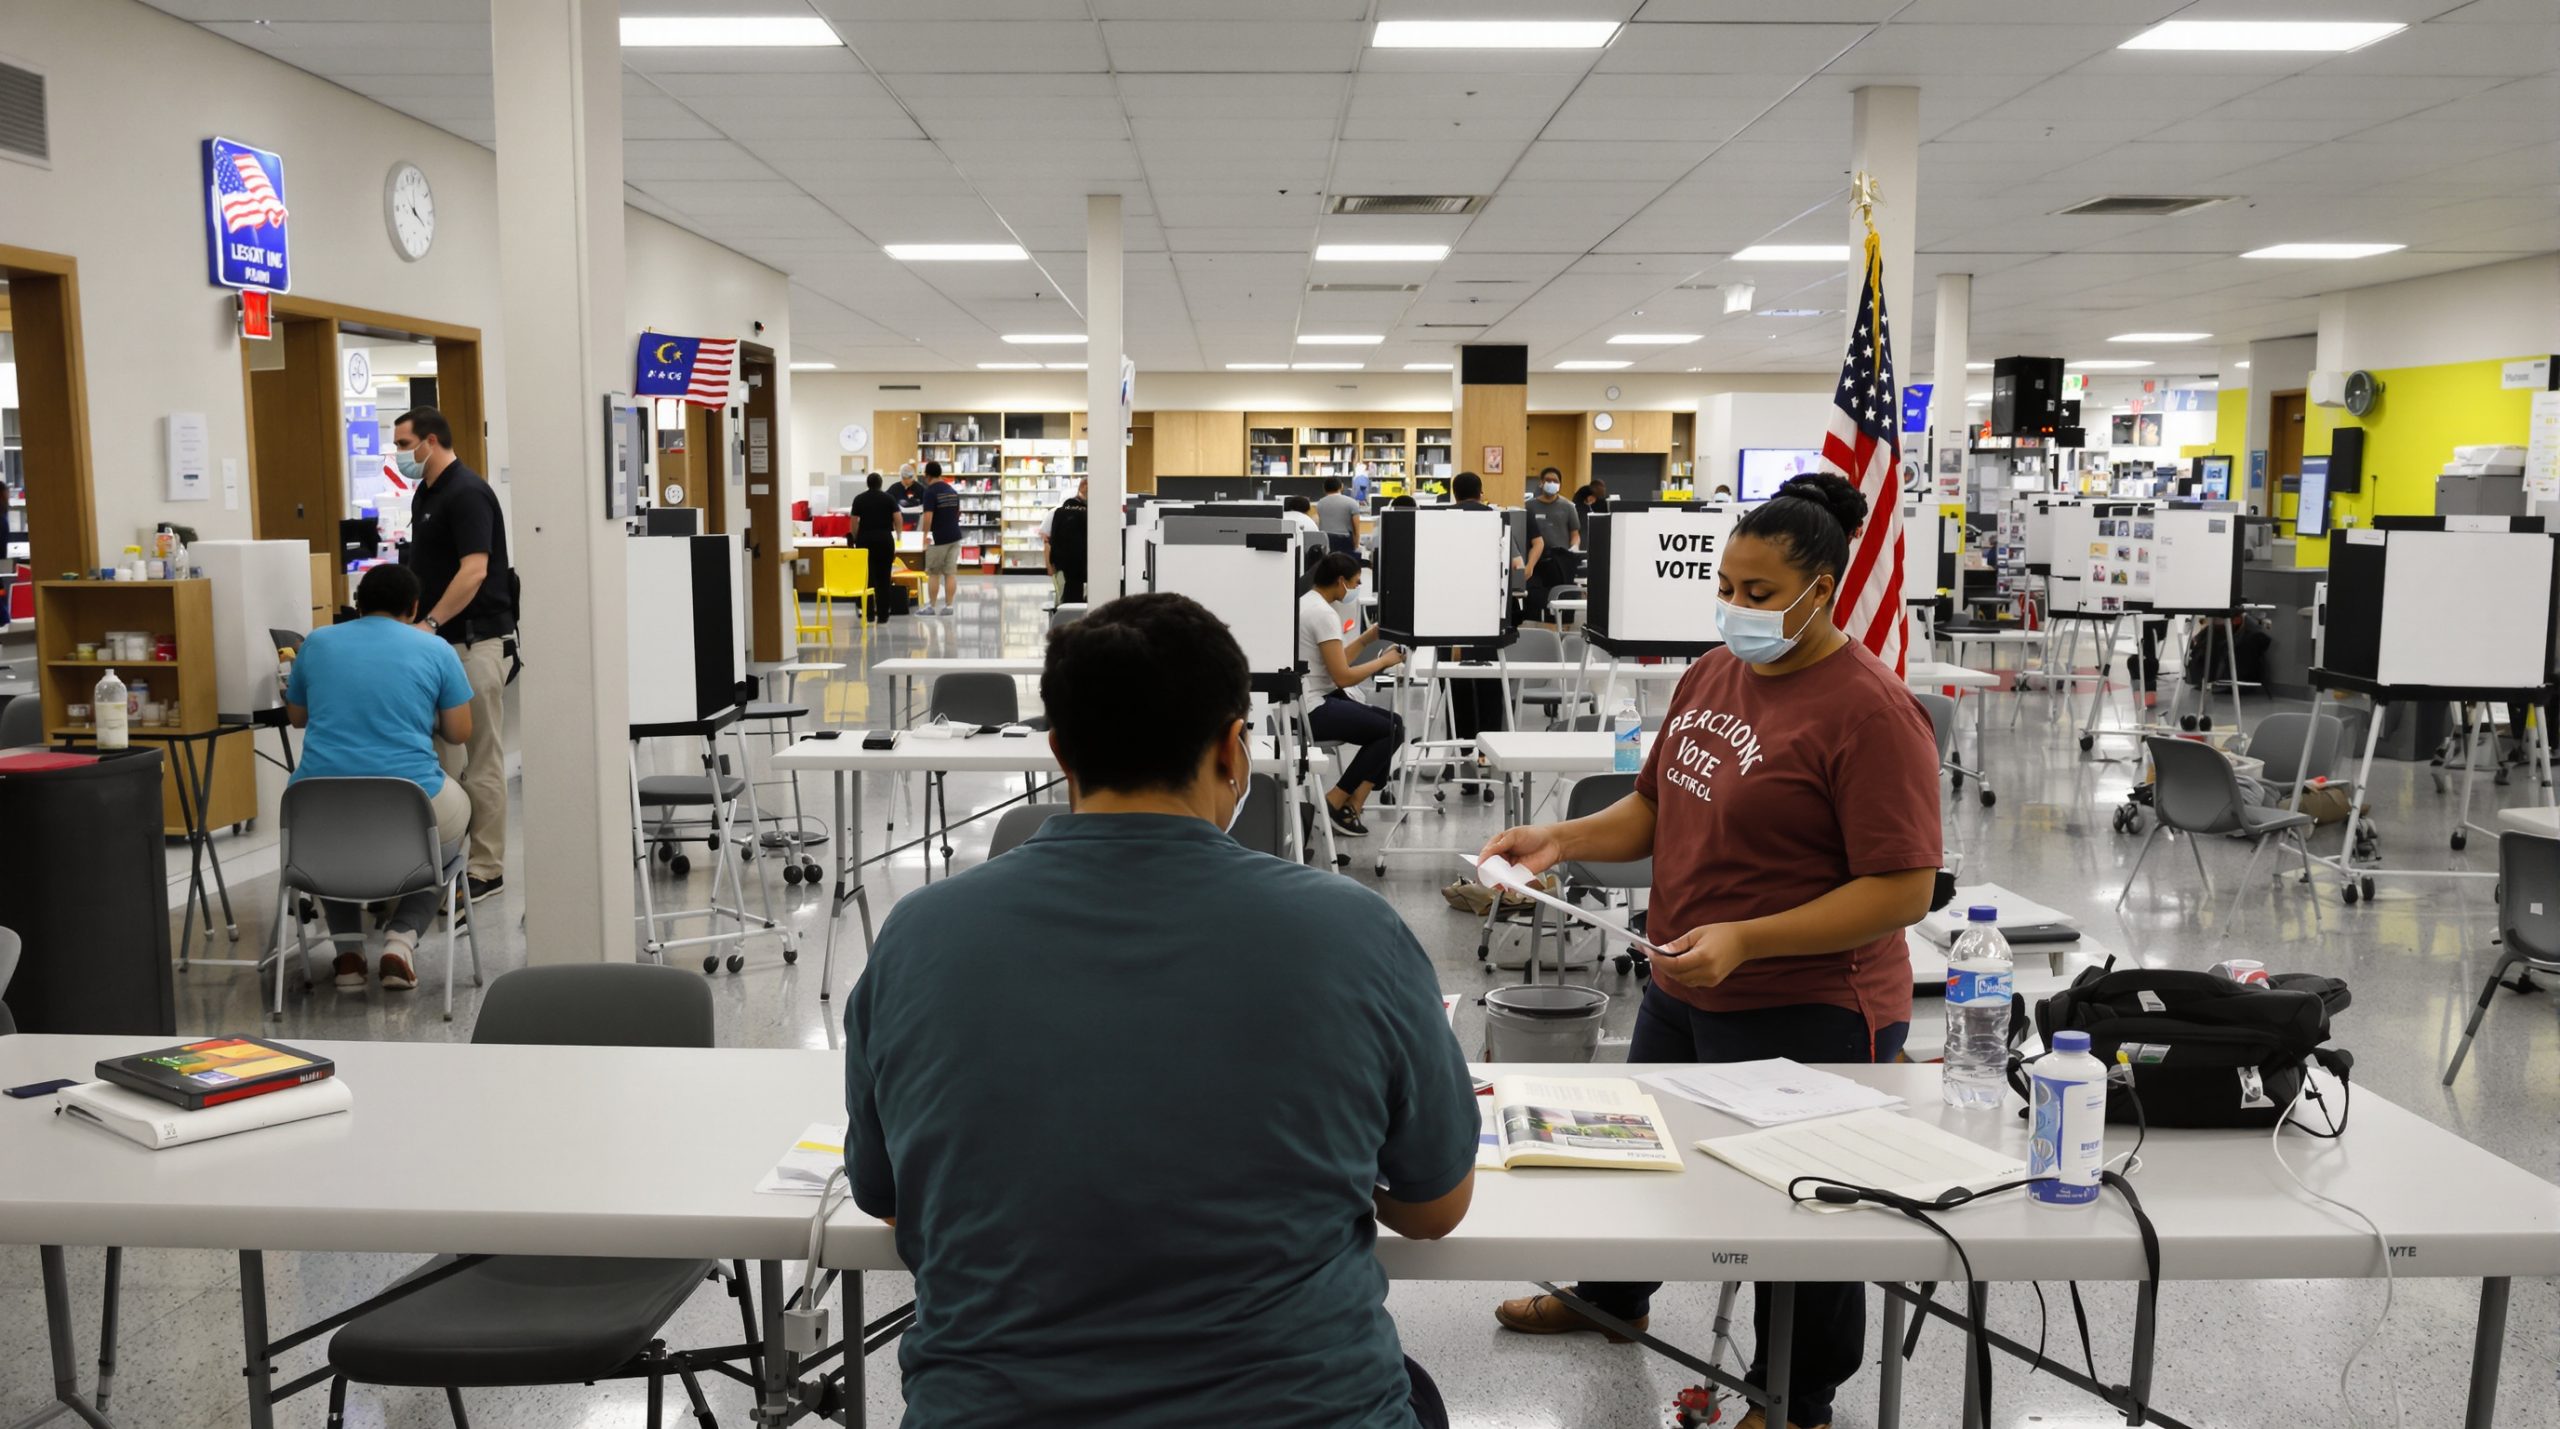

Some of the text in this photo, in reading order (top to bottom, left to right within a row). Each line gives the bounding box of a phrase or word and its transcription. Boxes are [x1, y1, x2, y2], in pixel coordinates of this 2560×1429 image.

[1658, 533, 1715, 553] VOTE
[1655, 560, 1712, 580] VOTE
[1676, 736, 1721, 778] VOTE
